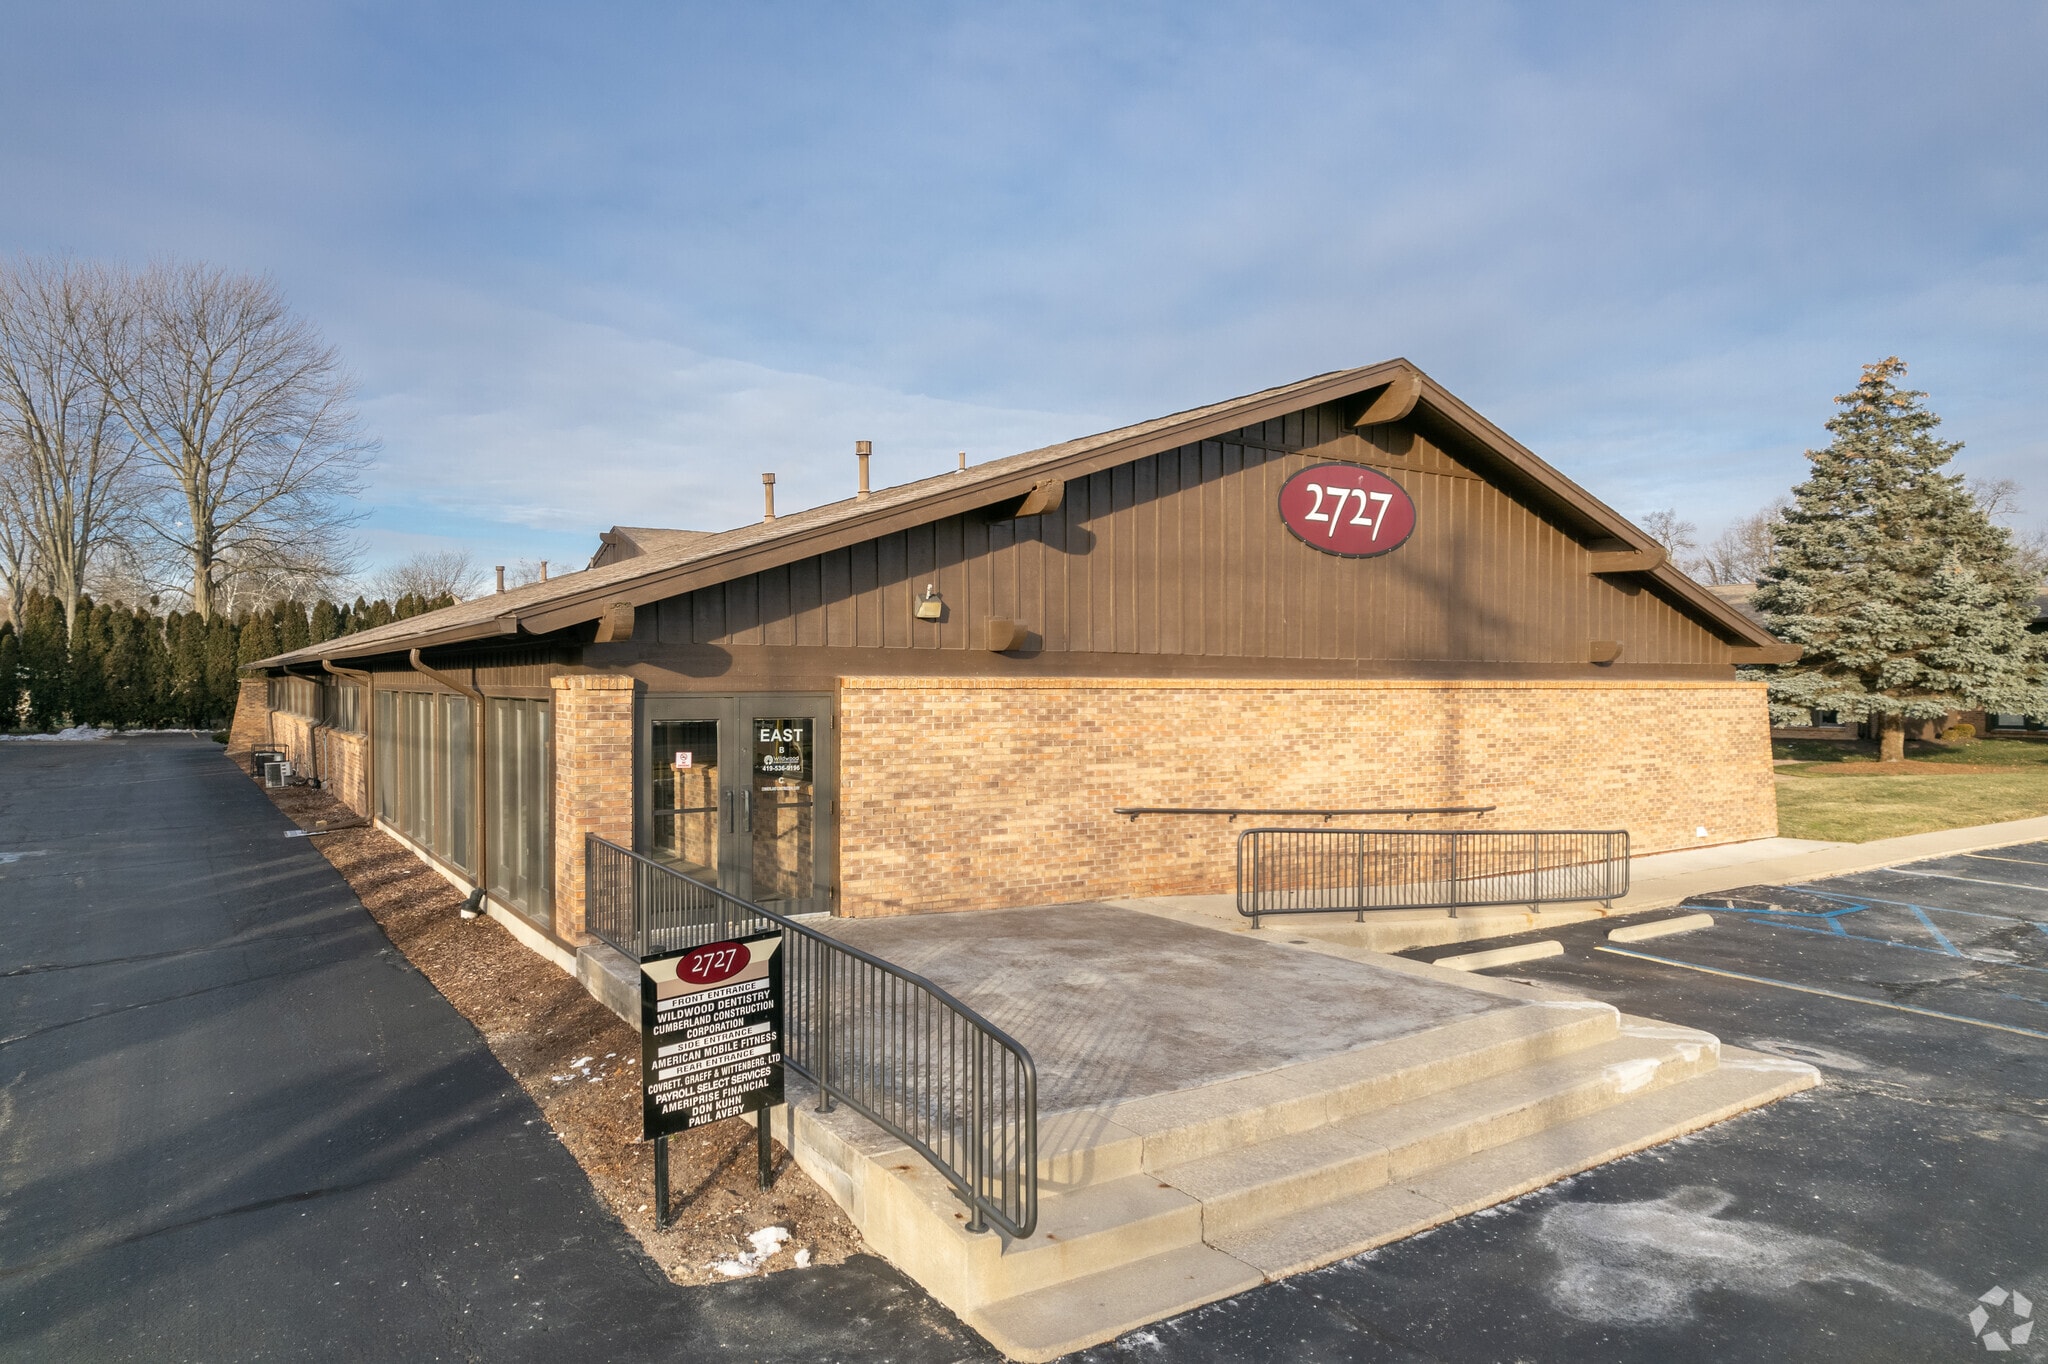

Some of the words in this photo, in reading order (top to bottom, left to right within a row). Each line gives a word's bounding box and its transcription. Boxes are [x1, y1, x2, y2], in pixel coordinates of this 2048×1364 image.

[1304, 483, 1393, 542] 2727
[760, 729, 803, 742] EAST
[692, 949, 737, 977] 2727
[657, 1003, 714, 1023] WILDWOOD
[718, 990, 770, 1009] DENTISTRY
[672, 995, 704, 1007] FRONT
[708, 982, 756, 999] ENTRANCE
[653, 1014, 710, 1035] CUMBERLAND
[714, 1000, 774, 1021] CONSTRUCTION
[687, 1017, 744, 1039] CORPORATION
[652, 1053, 701, 1070] AMERICAN
[704, 1041, 738, 1057] MOBILE
[741, 1032, 777, 1048] FITNESS
[678, 1040, 700, 1051] SIDE
[704, 1027, 753, 1045] ENTRANCE
[676, 1062, 702, 1074] REAR
[706, 1049, 754, 1066] ENTRANCE
[685, 1070, 712, 1085] GRAEFF
[714, 1069, 719, 1077] &
[768, 1053, 781, 1064] LTD
[656, 1087, 696, 1105] PAYROLL
[697, 1078, 729, 1093] SELECT
[731, 1067, 771, 1085] SERVICES
[662, 1091, 720, 1114] AMERIPRISE
[722, 1078, 769, 1098] FINANCIAL
[689, 1114, 712, 1127] PAUL
[715, 1104, 745, 1120] AVERY
[692, 1104, 712, 1116] DON
[716, 1095, 741, 1110] KUHN
